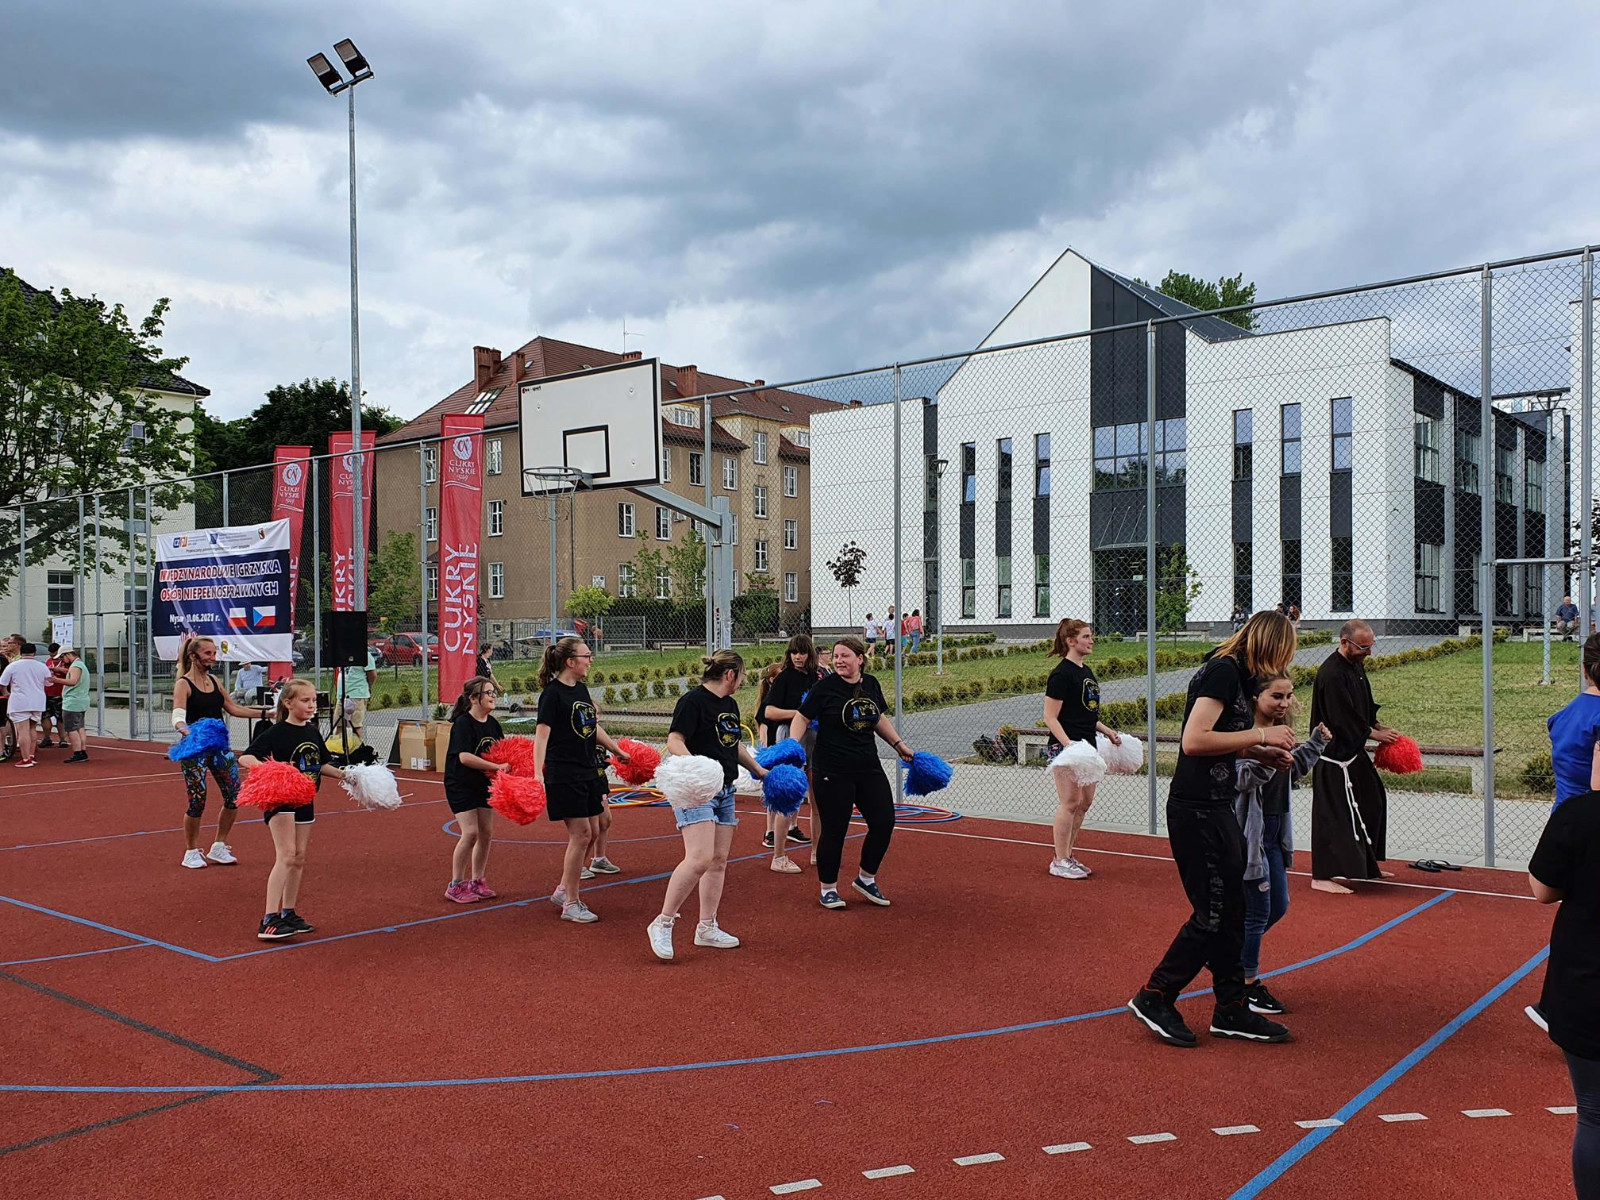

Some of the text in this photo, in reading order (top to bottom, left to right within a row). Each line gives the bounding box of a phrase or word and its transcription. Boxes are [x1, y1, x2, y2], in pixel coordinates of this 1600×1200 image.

[448, 466, 476, 475] NYSKIE
[449, 460, 475, 468] CUKRY
[235, 559, 282, 578] IGRZYSKA
[160, 581, 279, 601] OSÓB NIEPEŁNOSPRAWNYCH
[335, 551, 346, 612] KRY
[443, 543, 461, 652] CUKRY
[459, 542, 477, 655] NYSKIE
